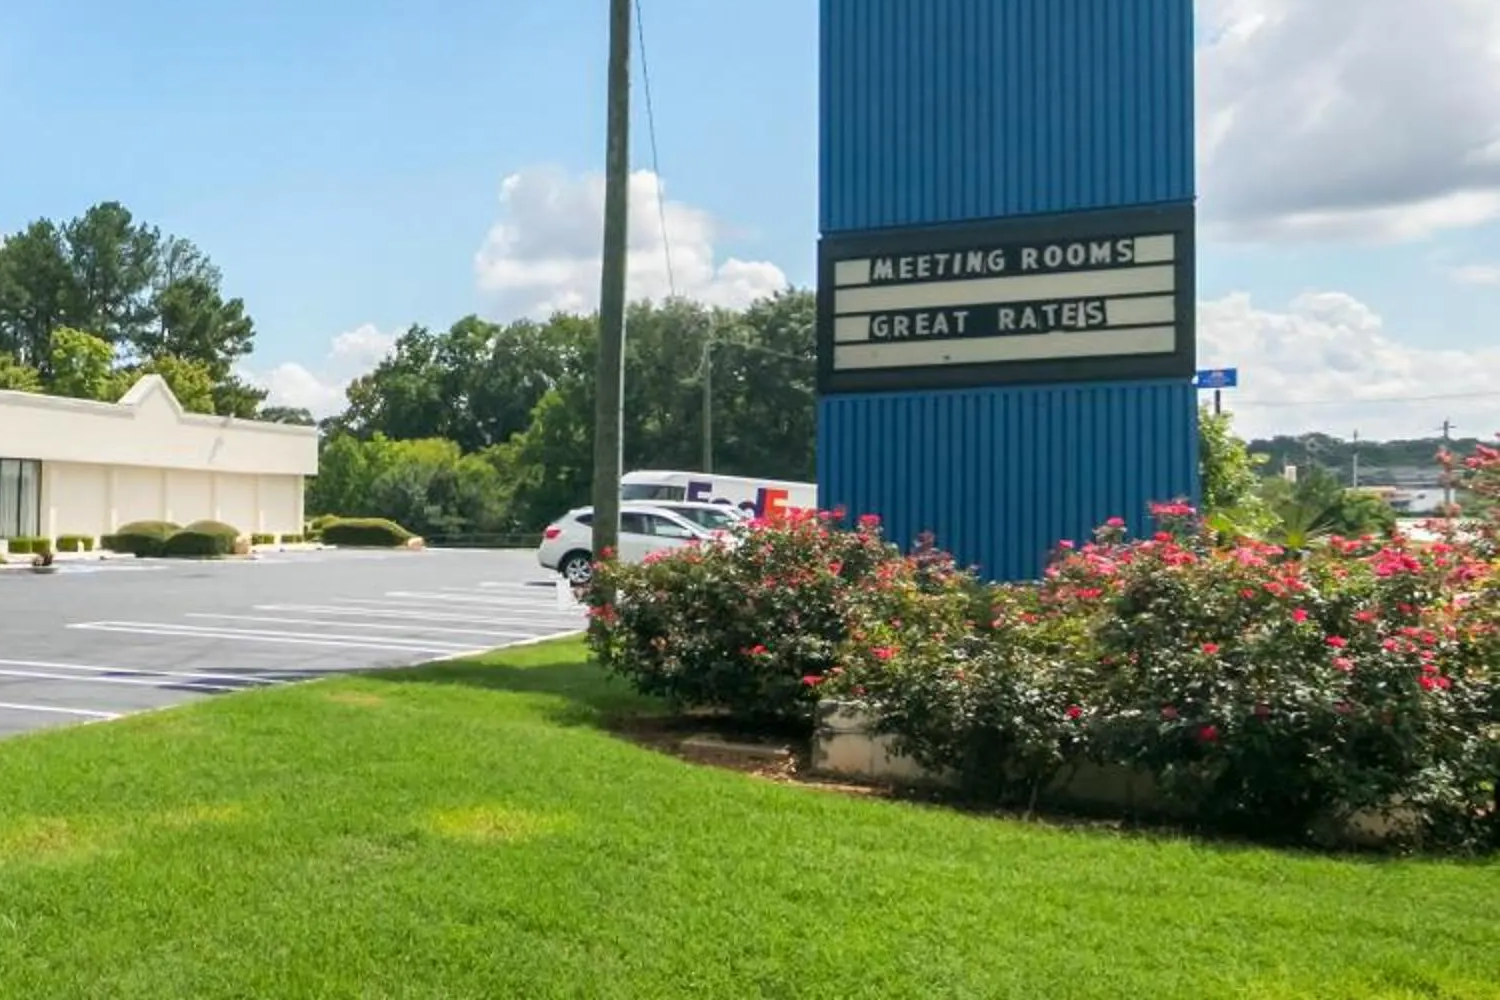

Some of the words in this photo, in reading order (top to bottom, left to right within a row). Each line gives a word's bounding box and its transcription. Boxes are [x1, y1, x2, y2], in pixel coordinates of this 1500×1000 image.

[873, 250, 1005, 279] MEETING
[1021, 239, 1133, 269] ROOMS
[872, 310, 969, 337] GREAT
[998, 301, 1103, 330] RATES
